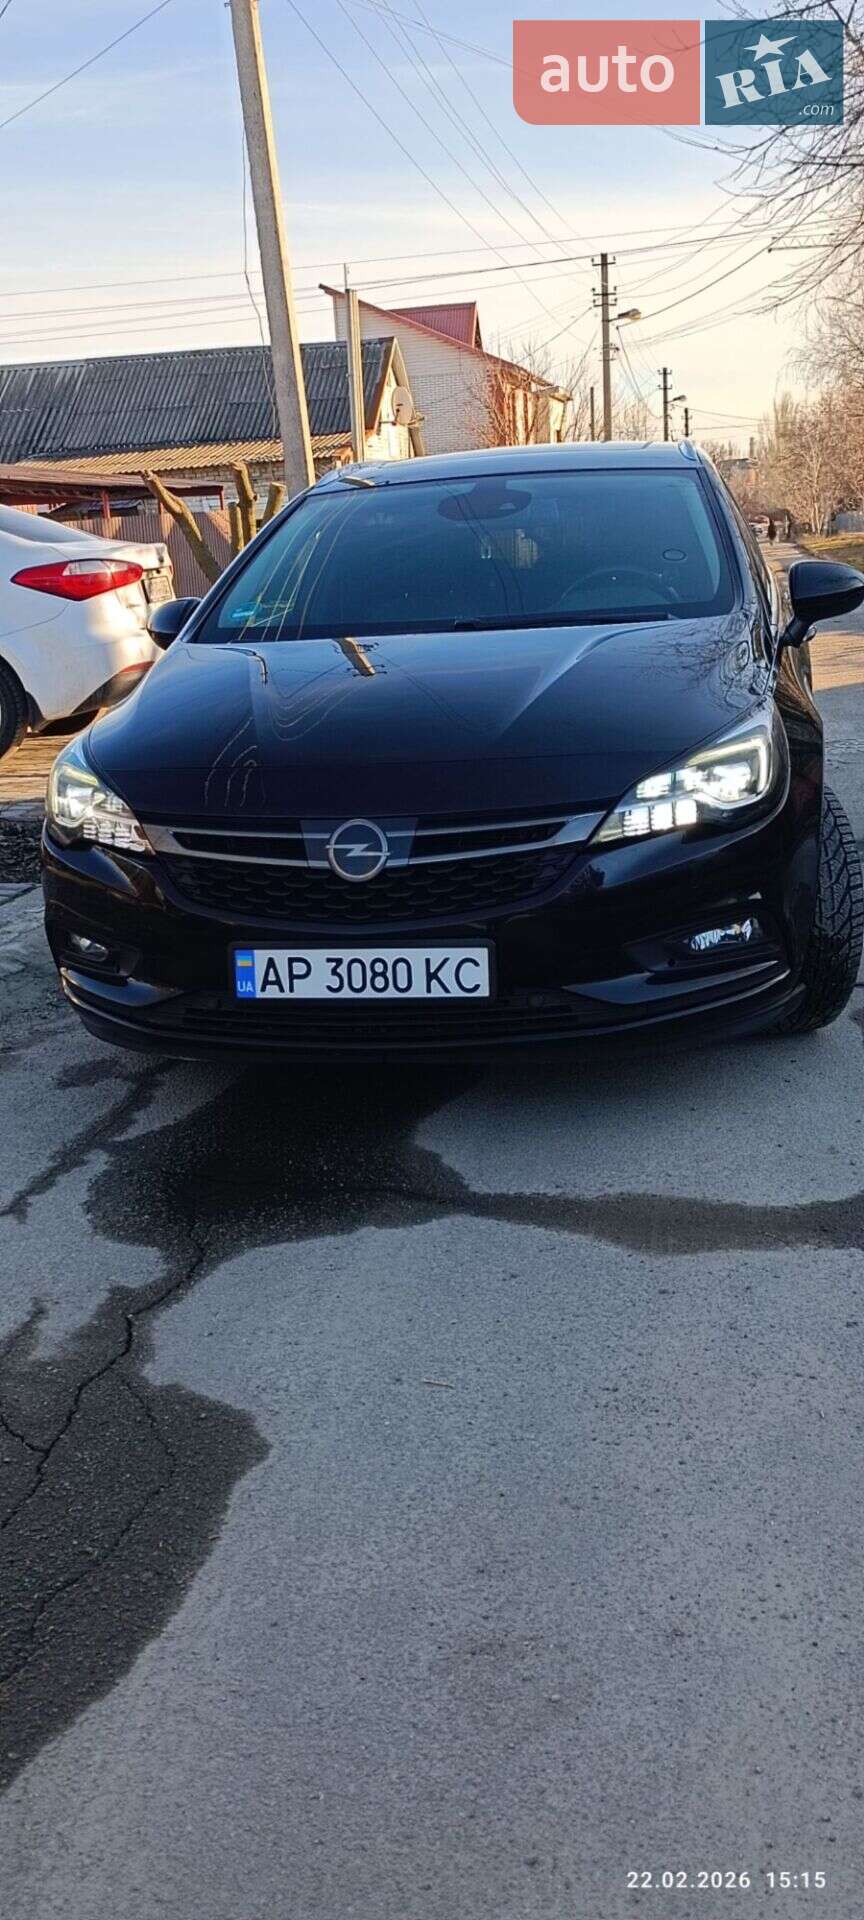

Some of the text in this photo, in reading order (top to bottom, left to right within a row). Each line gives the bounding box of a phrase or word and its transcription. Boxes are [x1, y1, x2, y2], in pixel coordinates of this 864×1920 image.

[237, 981, 254, 993] UA
[260, 956, 481, 994] AP 3080 KC
